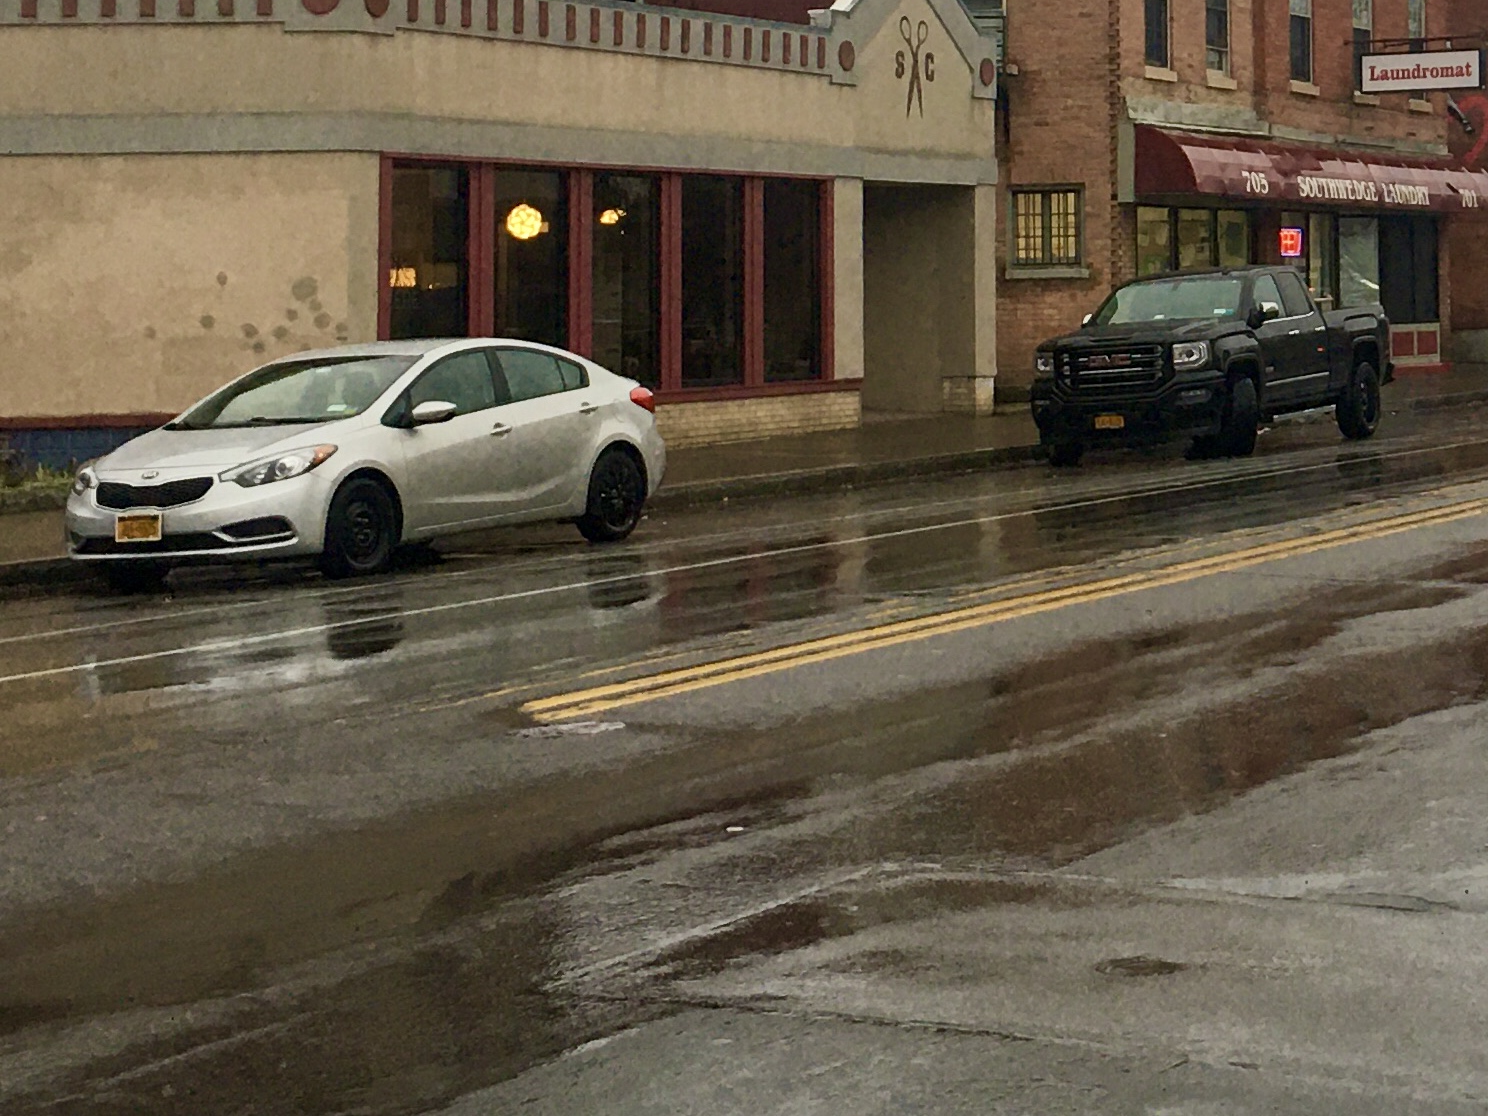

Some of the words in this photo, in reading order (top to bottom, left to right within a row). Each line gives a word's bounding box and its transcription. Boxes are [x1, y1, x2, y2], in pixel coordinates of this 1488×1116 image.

[895, 50, 905, 79] S
[925, 52, 935, 82] C
[1368, 61, 1473, 82] Laundromat
[1241, 170, 1269, 194] 705
[1297, 175, 1379, 202] SOUTHWEDGE
[1381, 183, 1430, 206] LAUNDRY
[1459, 188, 1478, 208] 701
